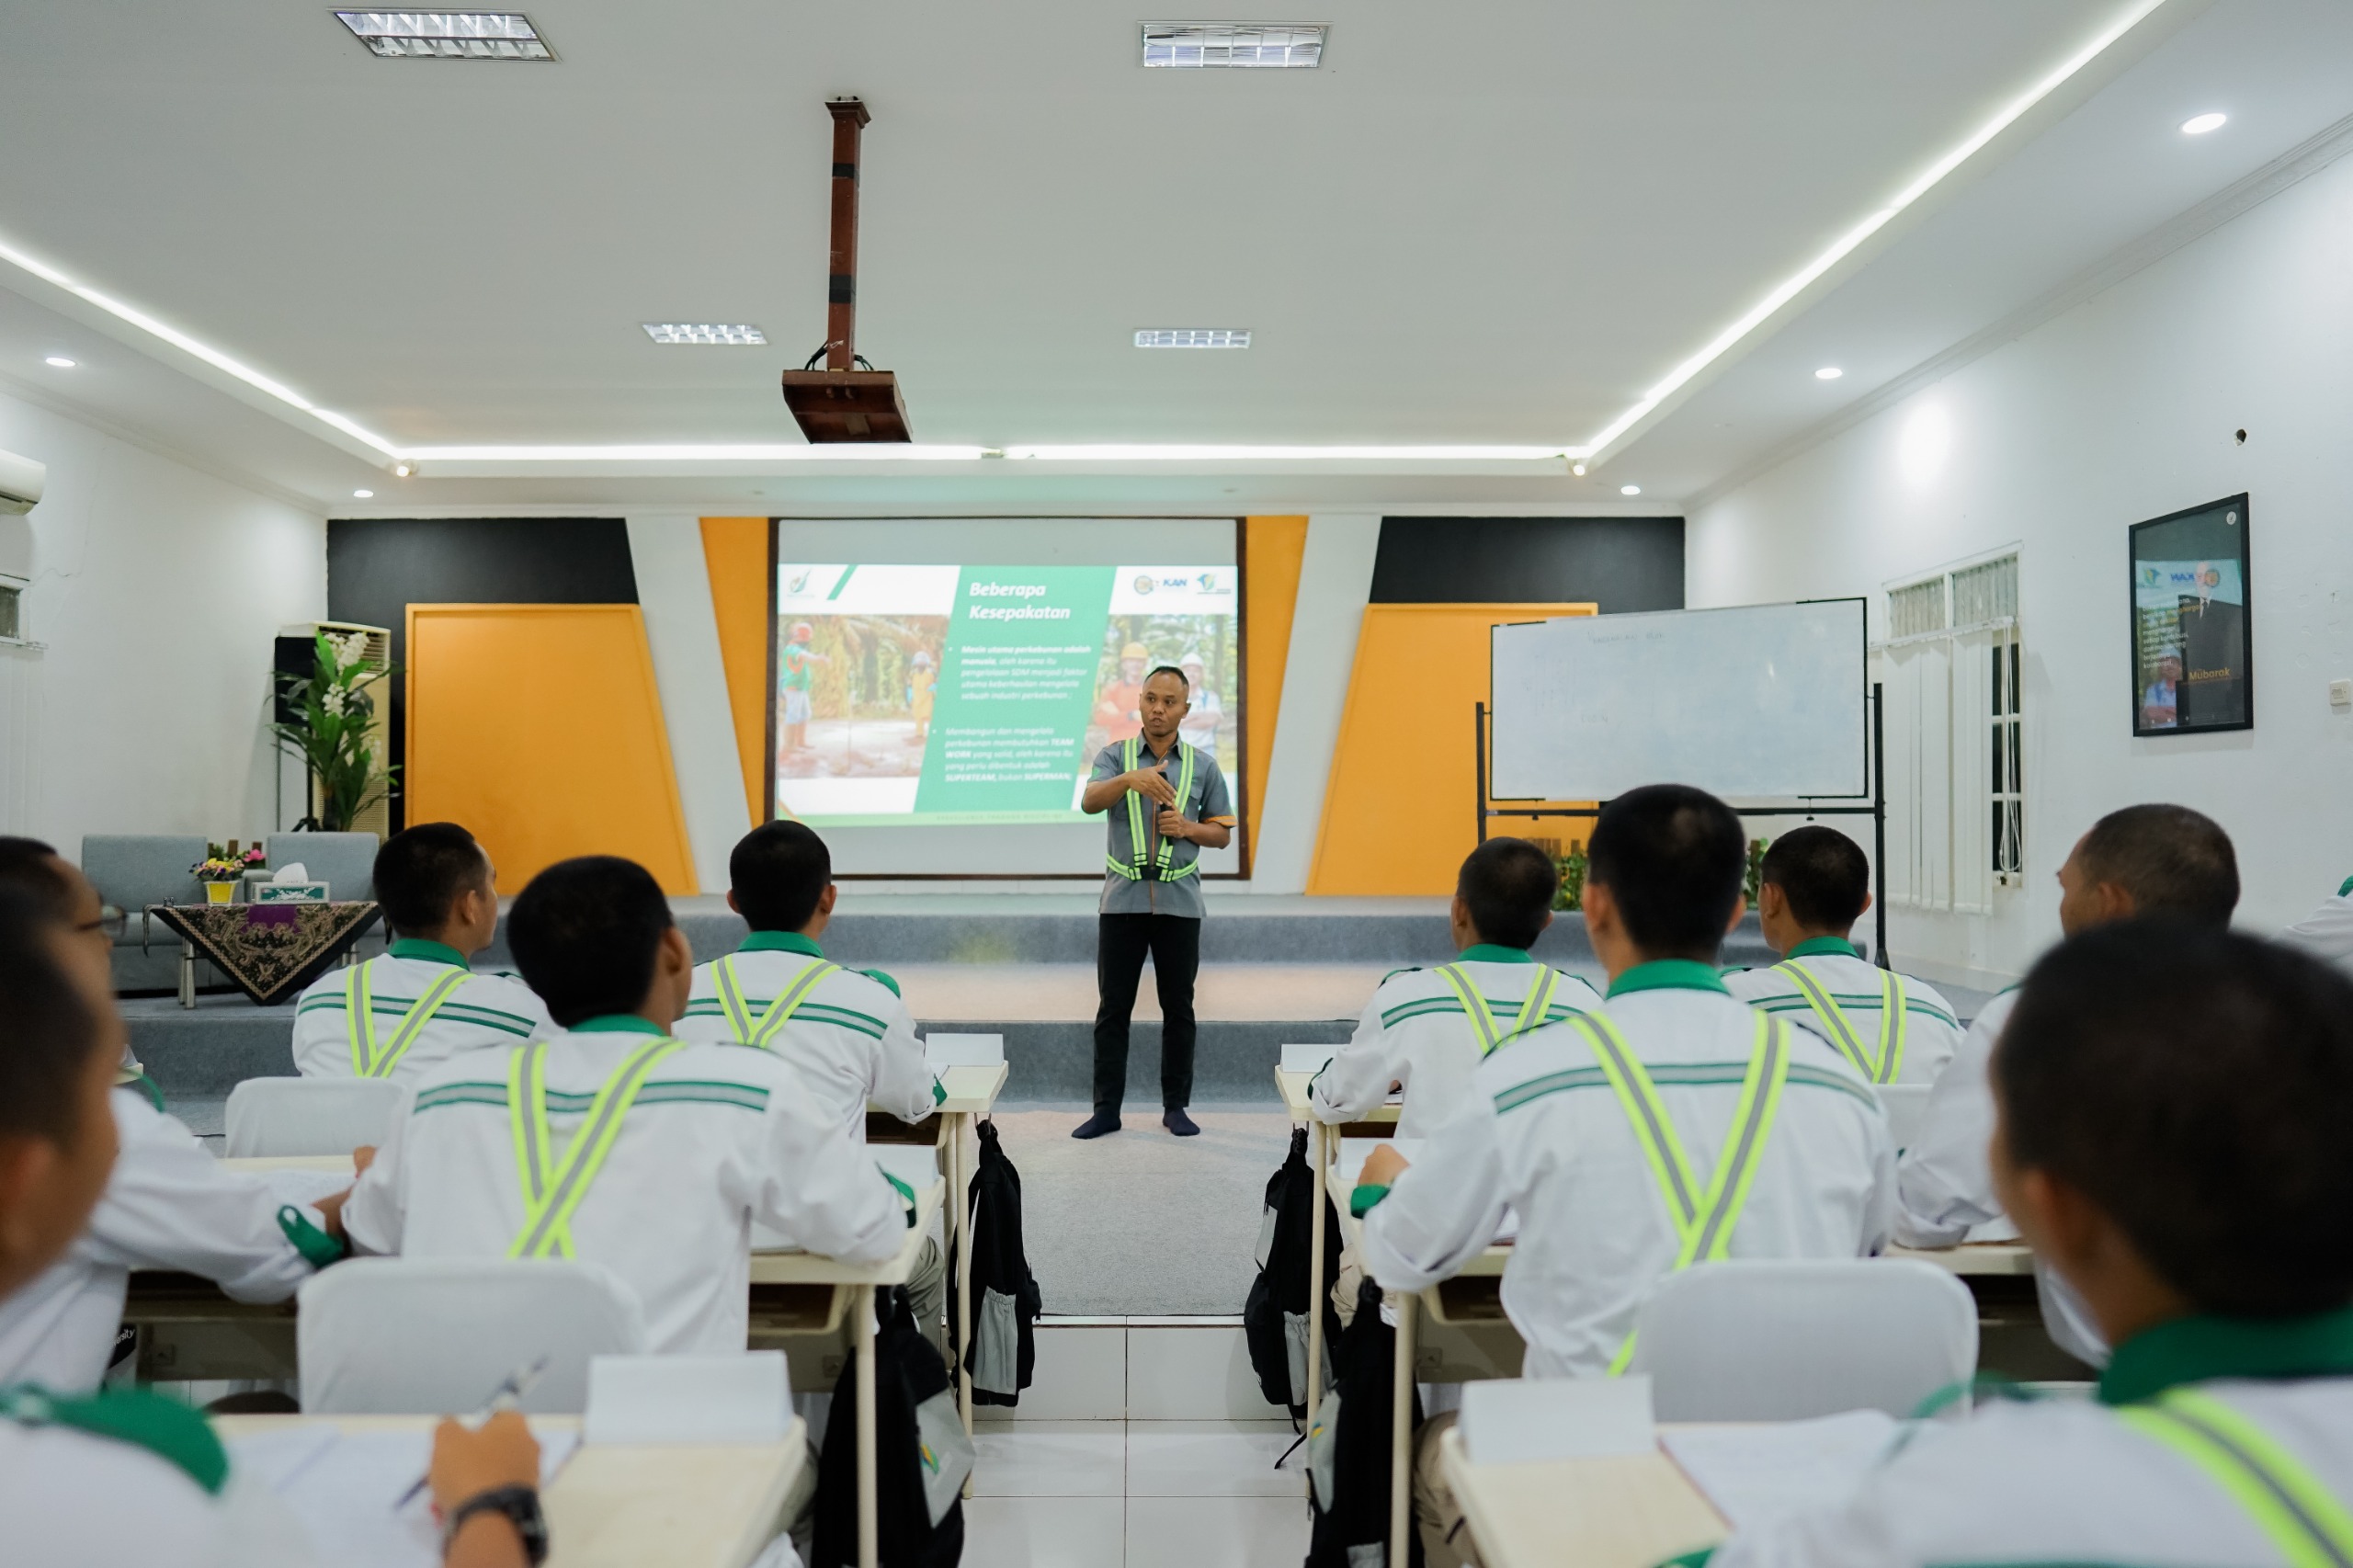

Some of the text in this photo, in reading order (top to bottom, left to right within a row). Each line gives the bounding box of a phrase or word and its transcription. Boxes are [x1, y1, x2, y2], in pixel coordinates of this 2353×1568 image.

[969, 582, 1046, 599] Beberapa
[969, 605, 1071, 622] Kesepakatan
[961, 645, 987, 653] Mesin
[1014, 645, 1063, 655] perkebunan
[1063, 645, 1091, 653] adalah
[1011, 668, 1029, 676] SDM
[1030, 668, 1062, 677] menjadi
[1063, 668, 1087, 677] faktor
[961, 680, 1080, 689] utama keberhasilan mengelola
[961, 691, 989, 699] sebuah
[991, 691, 1020, 699] industri
[1021, 691, 1068, 701] perkebunan
[945, 728, 995, 737] Membangun
[1013, 727, 1054, 737] mengelola
[945, 739, 992, 748] perkebunan
[1051, 738, 1074, 746] TEAM
[945, 751, 972, 759] WORK
[972, 751, 993, 760] yang
[945, 763, 965, 771] yang
[998, 773, 1023, 781] bukan
